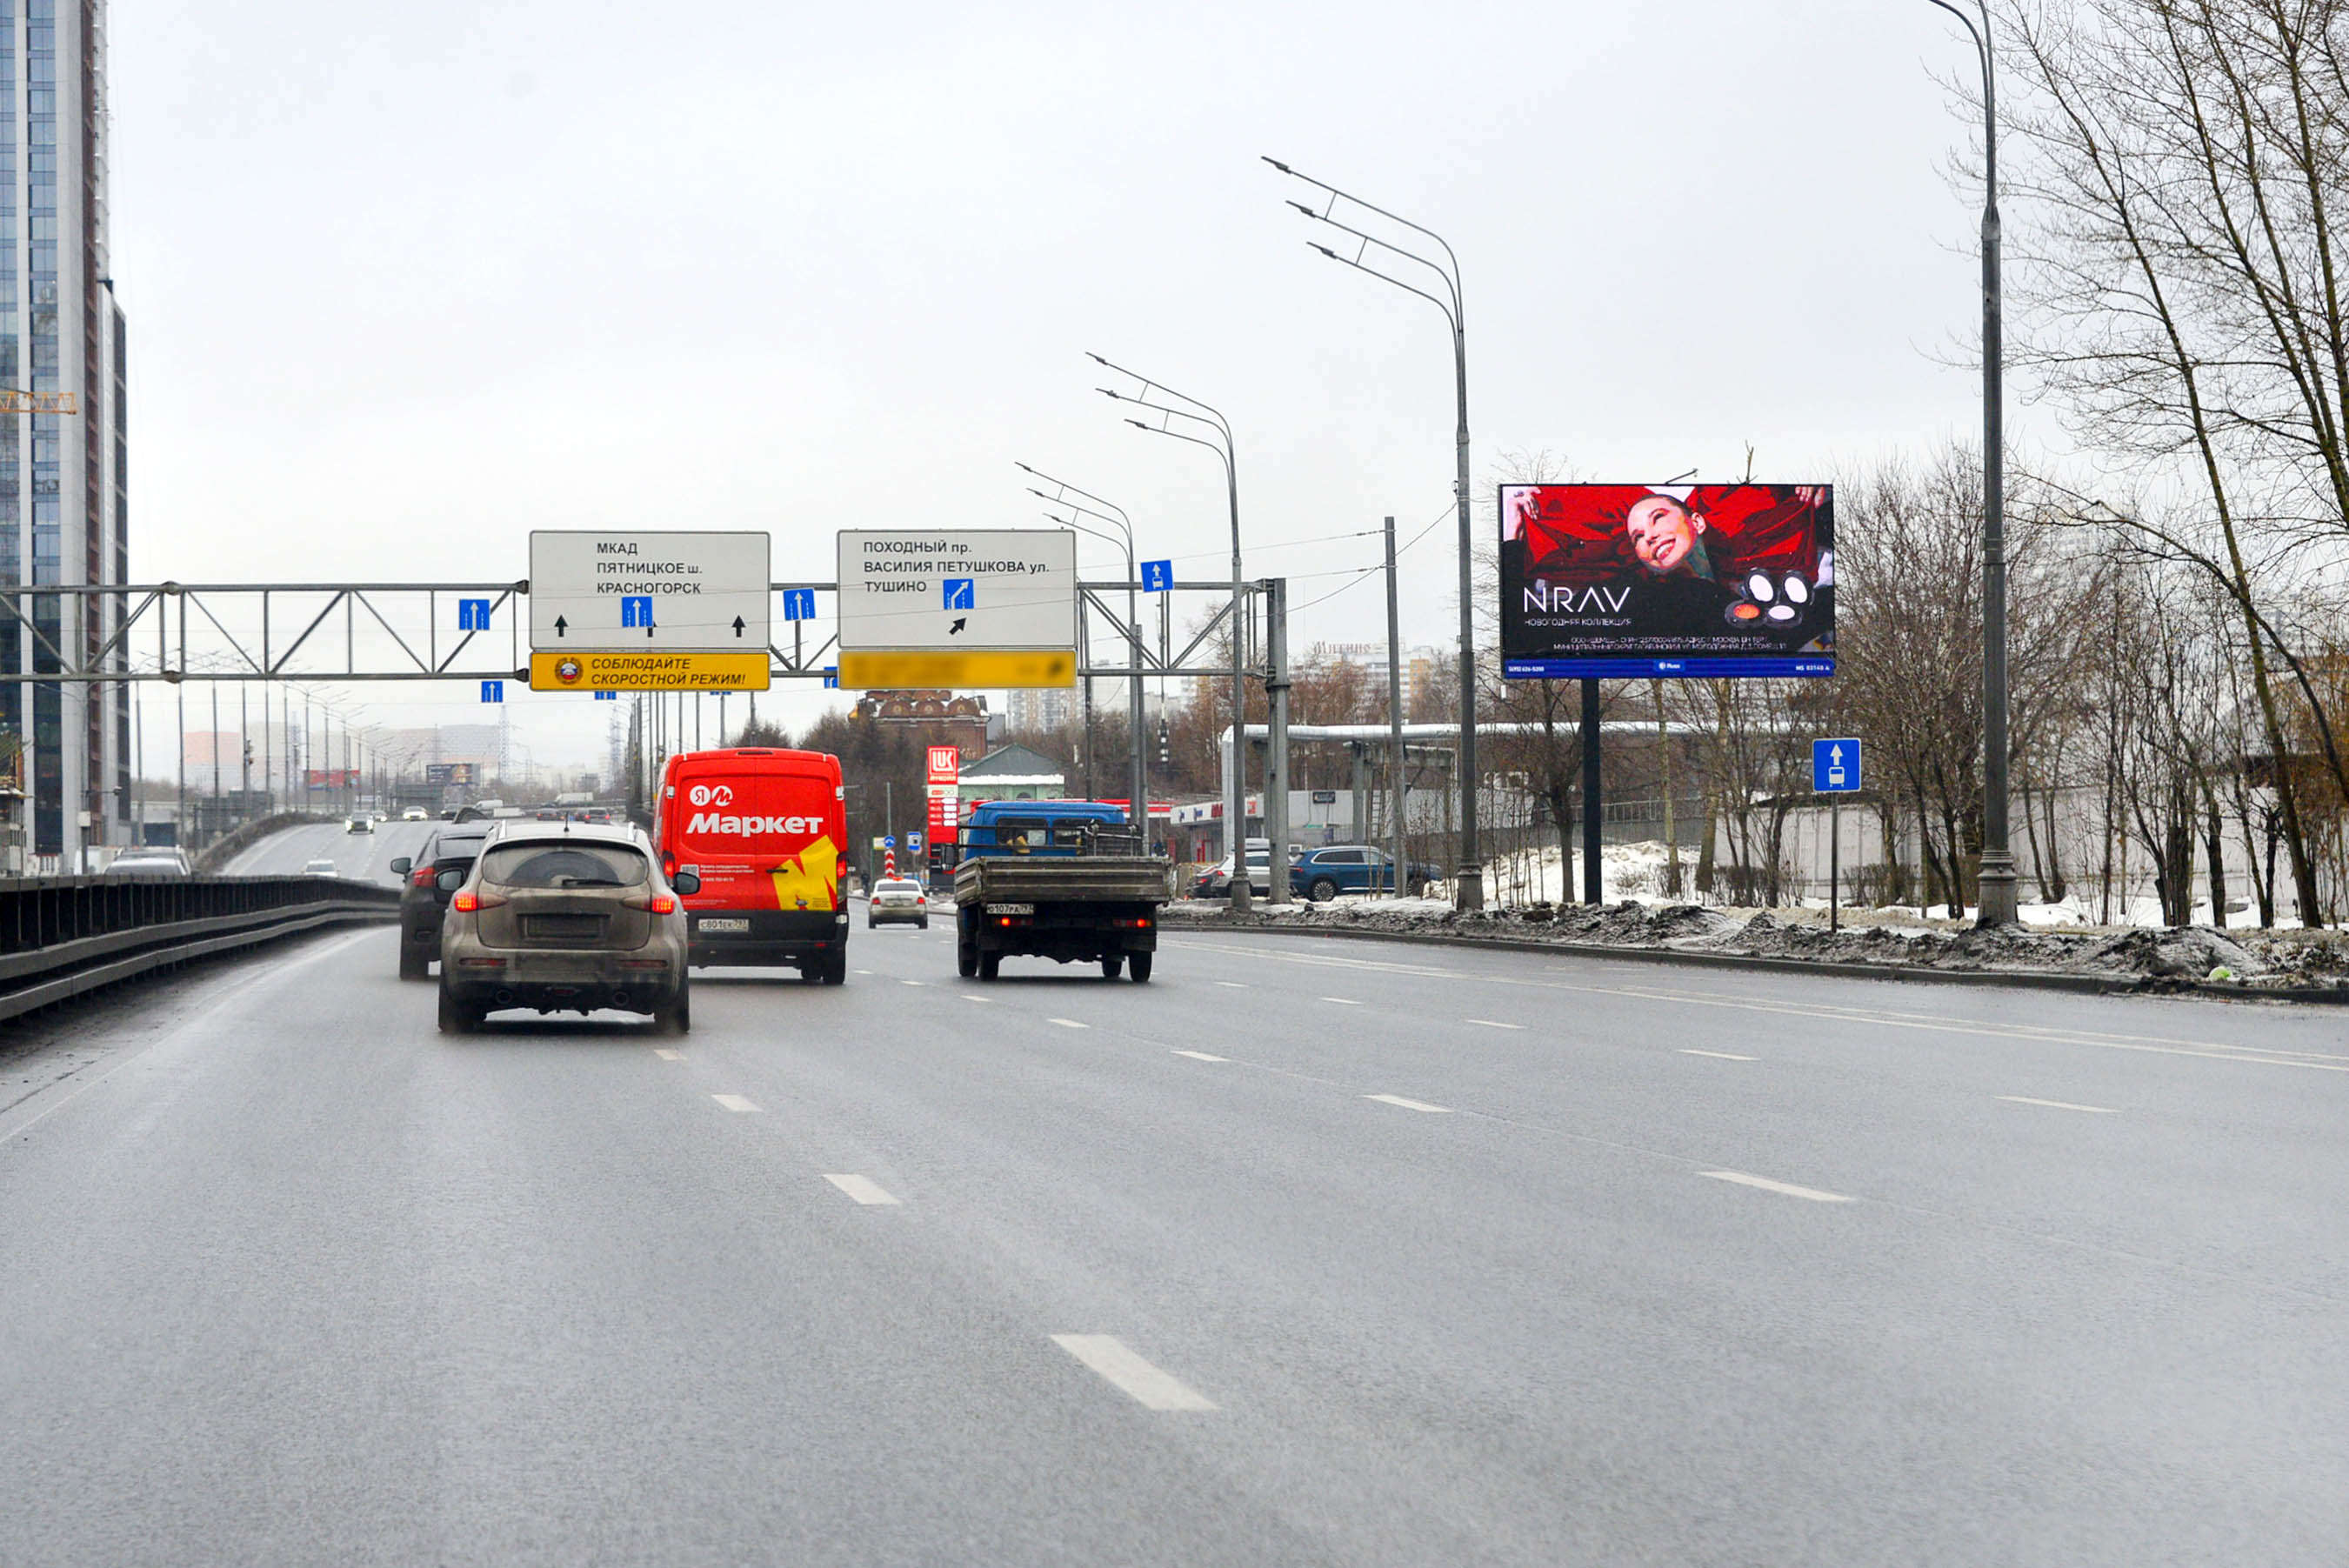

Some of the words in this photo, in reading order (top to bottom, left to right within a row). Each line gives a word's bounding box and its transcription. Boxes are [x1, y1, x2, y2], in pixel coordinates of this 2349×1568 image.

[597, 543, 638, 556] МКАД
[864, 539, 947, 554] ПОХОДНЫЙ
[951, 546, 972, 556] пр.
[597, 563, 684, 576] ПЯТНИЦКОЕ
[687, 565, 703, 574] ш.
[864, 561, 933, 573] ВАСИЛИЯ
[937, 561, 1026, 572] ПЕТУШКОВА
[1029, 565, 1050, 575] ул.
[597, 582, 701, 595] КРАСНОГОРСК
[864, 581, 927, 592] ТУШИНО
[1524, 586, 1632, 613] NRAV
[591, 657, 691, 671] СОБЛЮДАЙТЕ
[591, 672, 687, 685] СКОРОСТНОЙ
[690, 674, 746, 685] РЕЖИМ!
[686, 812, 824, 837] Маркет
